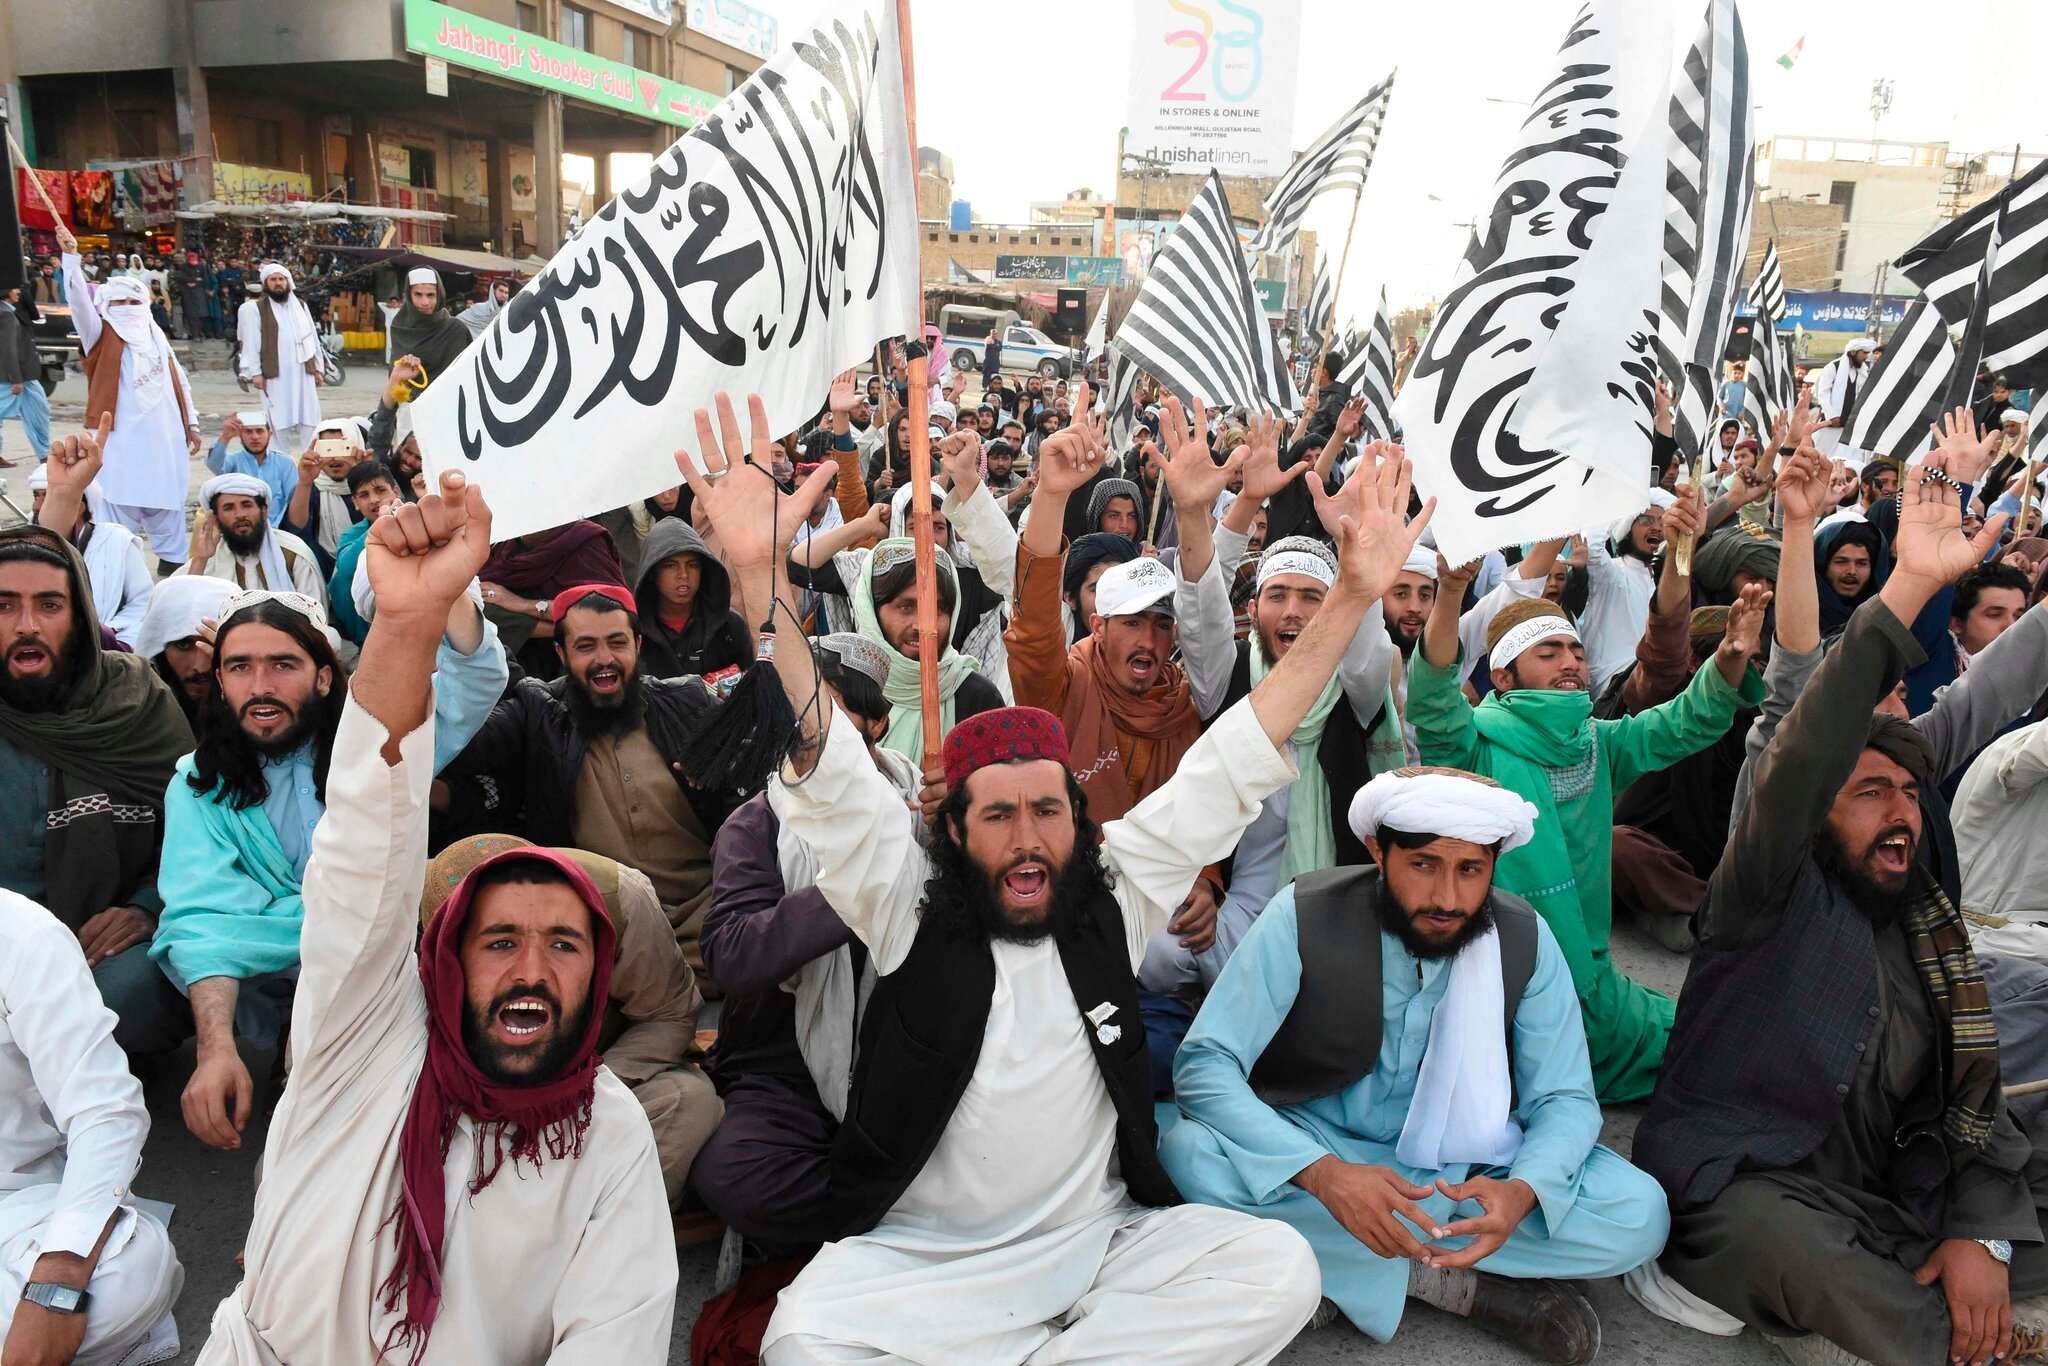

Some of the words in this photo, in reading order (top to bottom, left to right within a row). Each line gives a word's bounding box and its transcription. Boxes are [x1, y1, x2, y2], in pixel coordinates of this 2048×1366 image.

[436, 16, 525, 71] Jahangir
[528, 45, 598, 90] Snooker
[601, 68, 634, 102] Club
[1161, 30, 1263, 102] 20
[1159, 108, 1170, 116] IN
[1172, 108, 1211, 117] STORES
[1213, 109, 1220, 117] &
[1222, 109, 1260, 118] ONLINE
